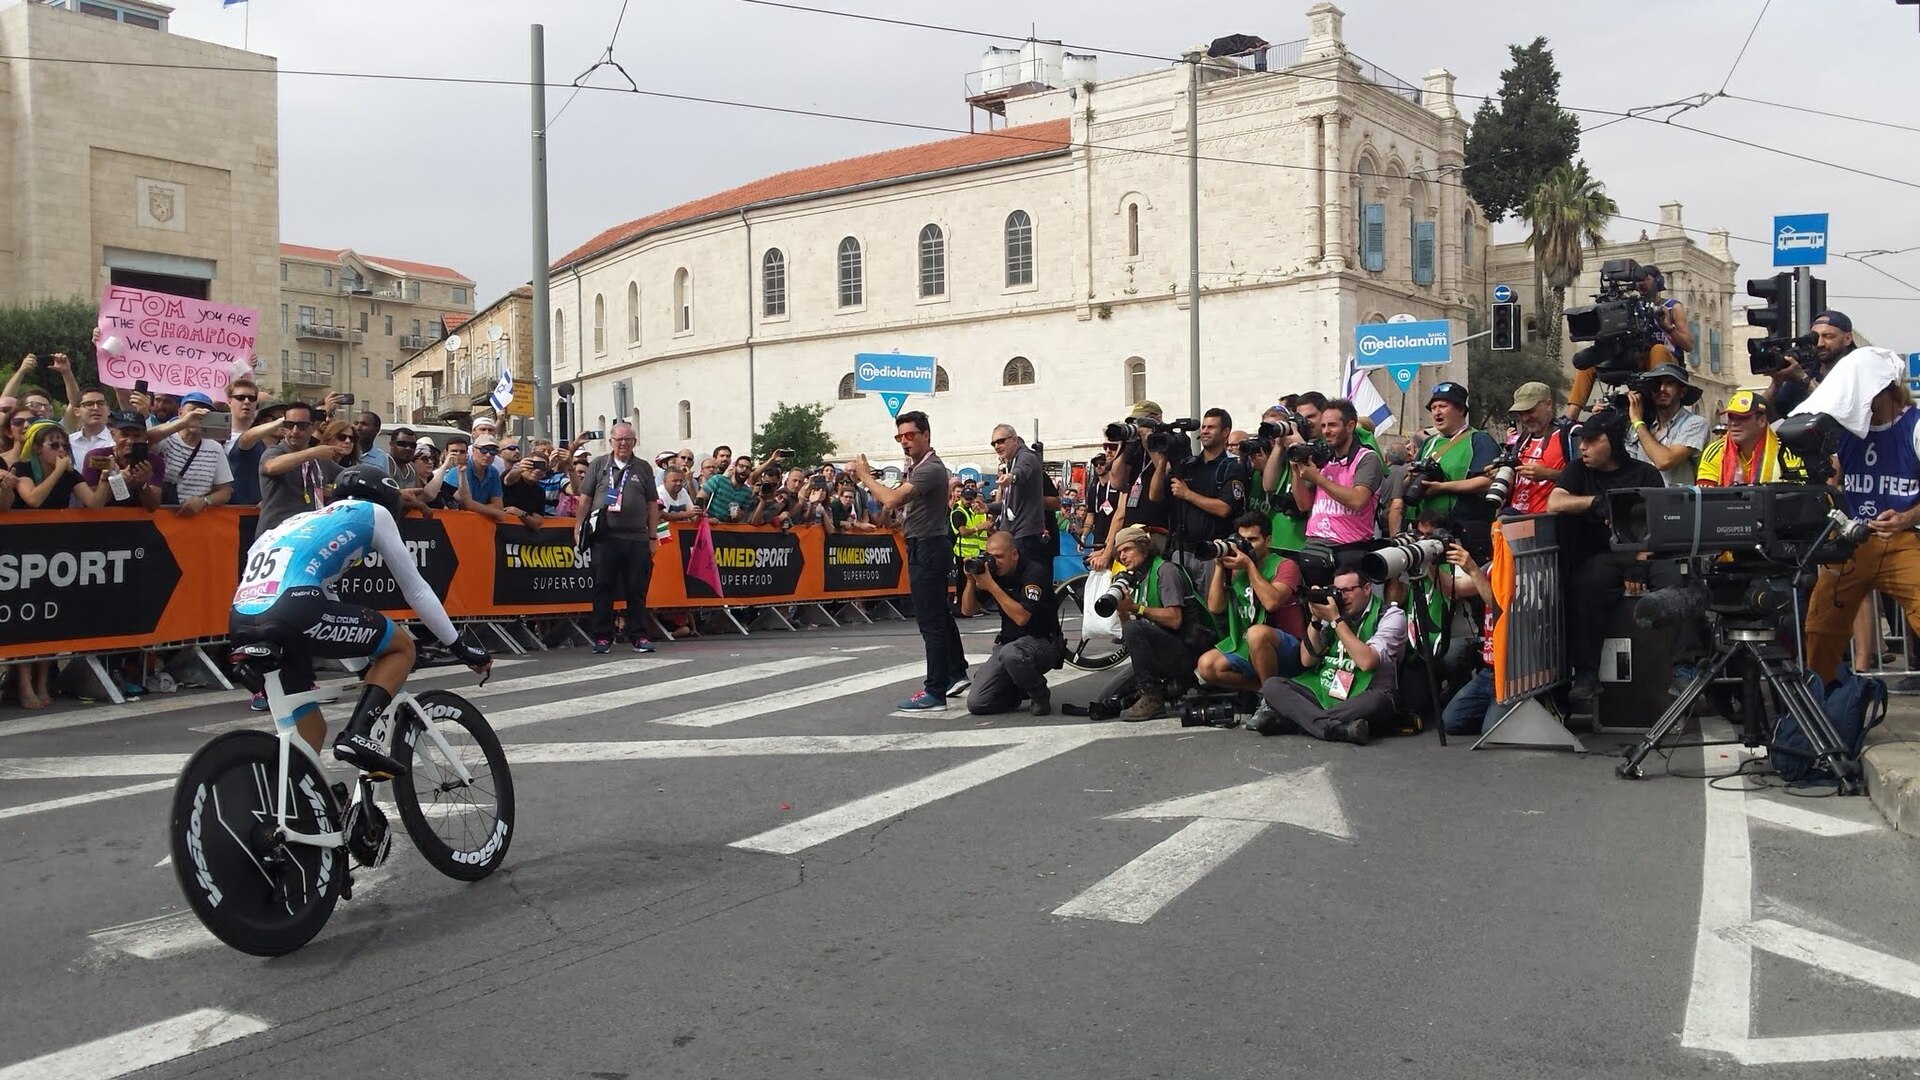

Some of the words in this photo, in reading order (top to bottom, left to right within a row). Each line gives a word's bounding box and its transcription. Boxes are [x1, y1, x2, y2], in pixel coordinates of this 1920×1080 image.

[110, 288, 185, 319] TOM
[227, 313, 251, 327] ARE
[106, 315, 136, 329] THE
[126, 336, 171, 356] WE'VE
[175, 346, 206, 360] GOT
[1362, 334, 1447, 351] mediolanum
[861, 364, 932, 380] mediolanum
[1865, 442, 1877, 466] 6
[1879, 475, 1920, 497] FEED
[305, 558, 321, 578] DE
[319, 530, 357, 560] ROSA
[715, 547, 790, 568] AMEDSPORT
[246, 548, 281, 583] 95
[843, 570, 880, 580] SUPERFOOD
[533, 576, 594, 590] SUPERFOO
[721, 574, 773, 586] UPERFOOD
[336, 616, 359, 625] CYCLING
[303, 622, 378, 645] ACADEMY
